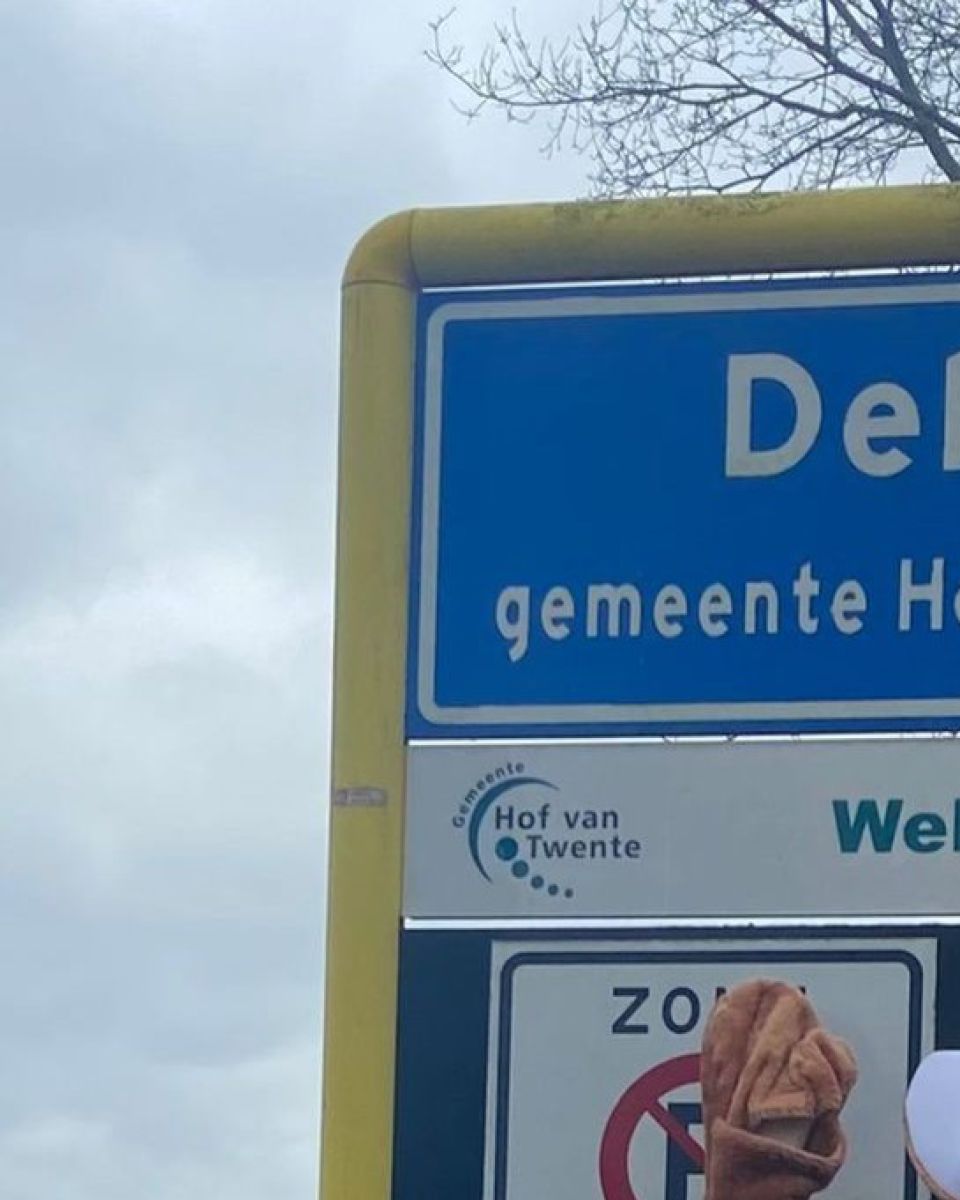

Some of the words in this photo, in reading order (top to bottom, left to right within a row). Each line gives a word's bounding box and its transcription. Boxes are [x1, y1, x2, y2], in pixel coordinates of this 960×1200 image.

[496, 561, 867, 663] gemeente
[452, 762, 525, 828] Gemeente
[495, 803, 550, 830] Hof
[564, 809, 619, 830] van
[526, 835, 641, 859] Twente
